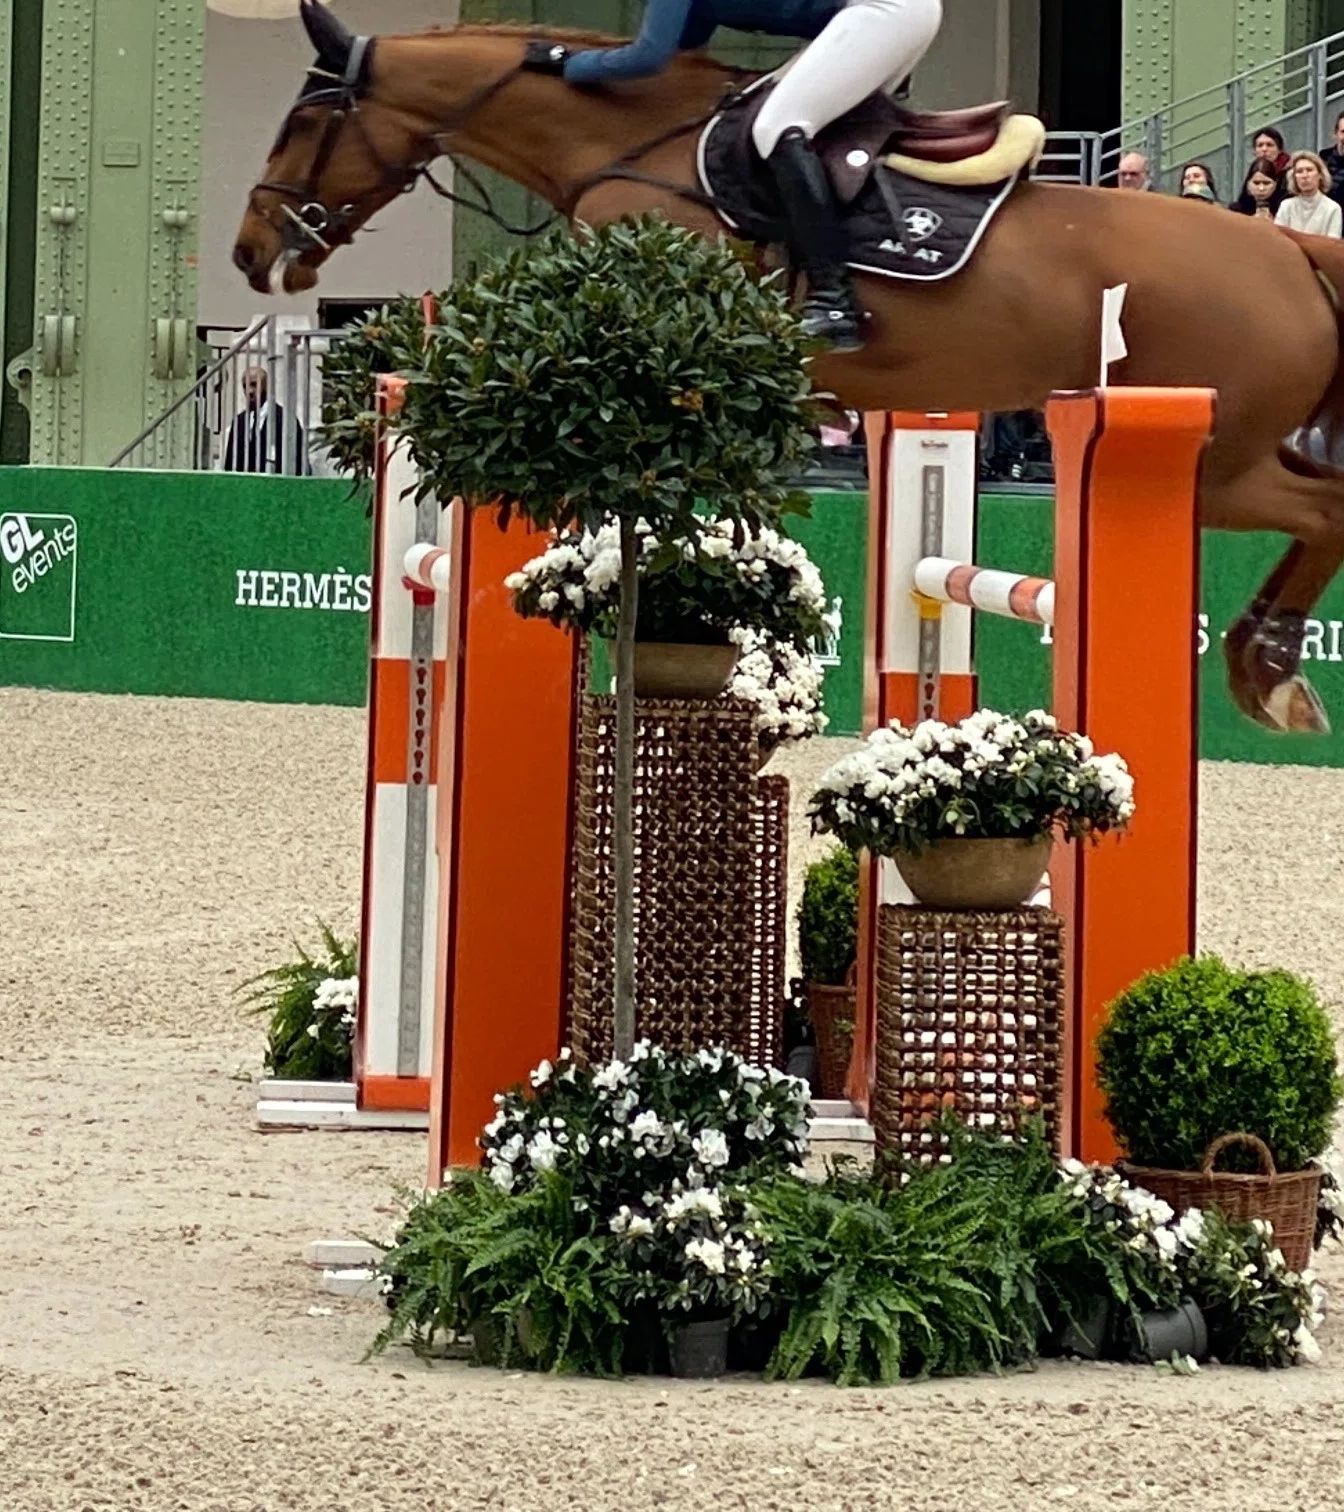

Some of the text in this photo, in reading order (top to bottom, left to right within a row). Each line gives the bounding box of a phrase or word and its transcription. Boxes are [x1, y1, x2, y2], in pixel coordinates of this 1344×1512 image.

[0, 515, 45, 564] GL
[12, 523, 76, 593] events
[234, 566, 373, 613] HERMÈS
